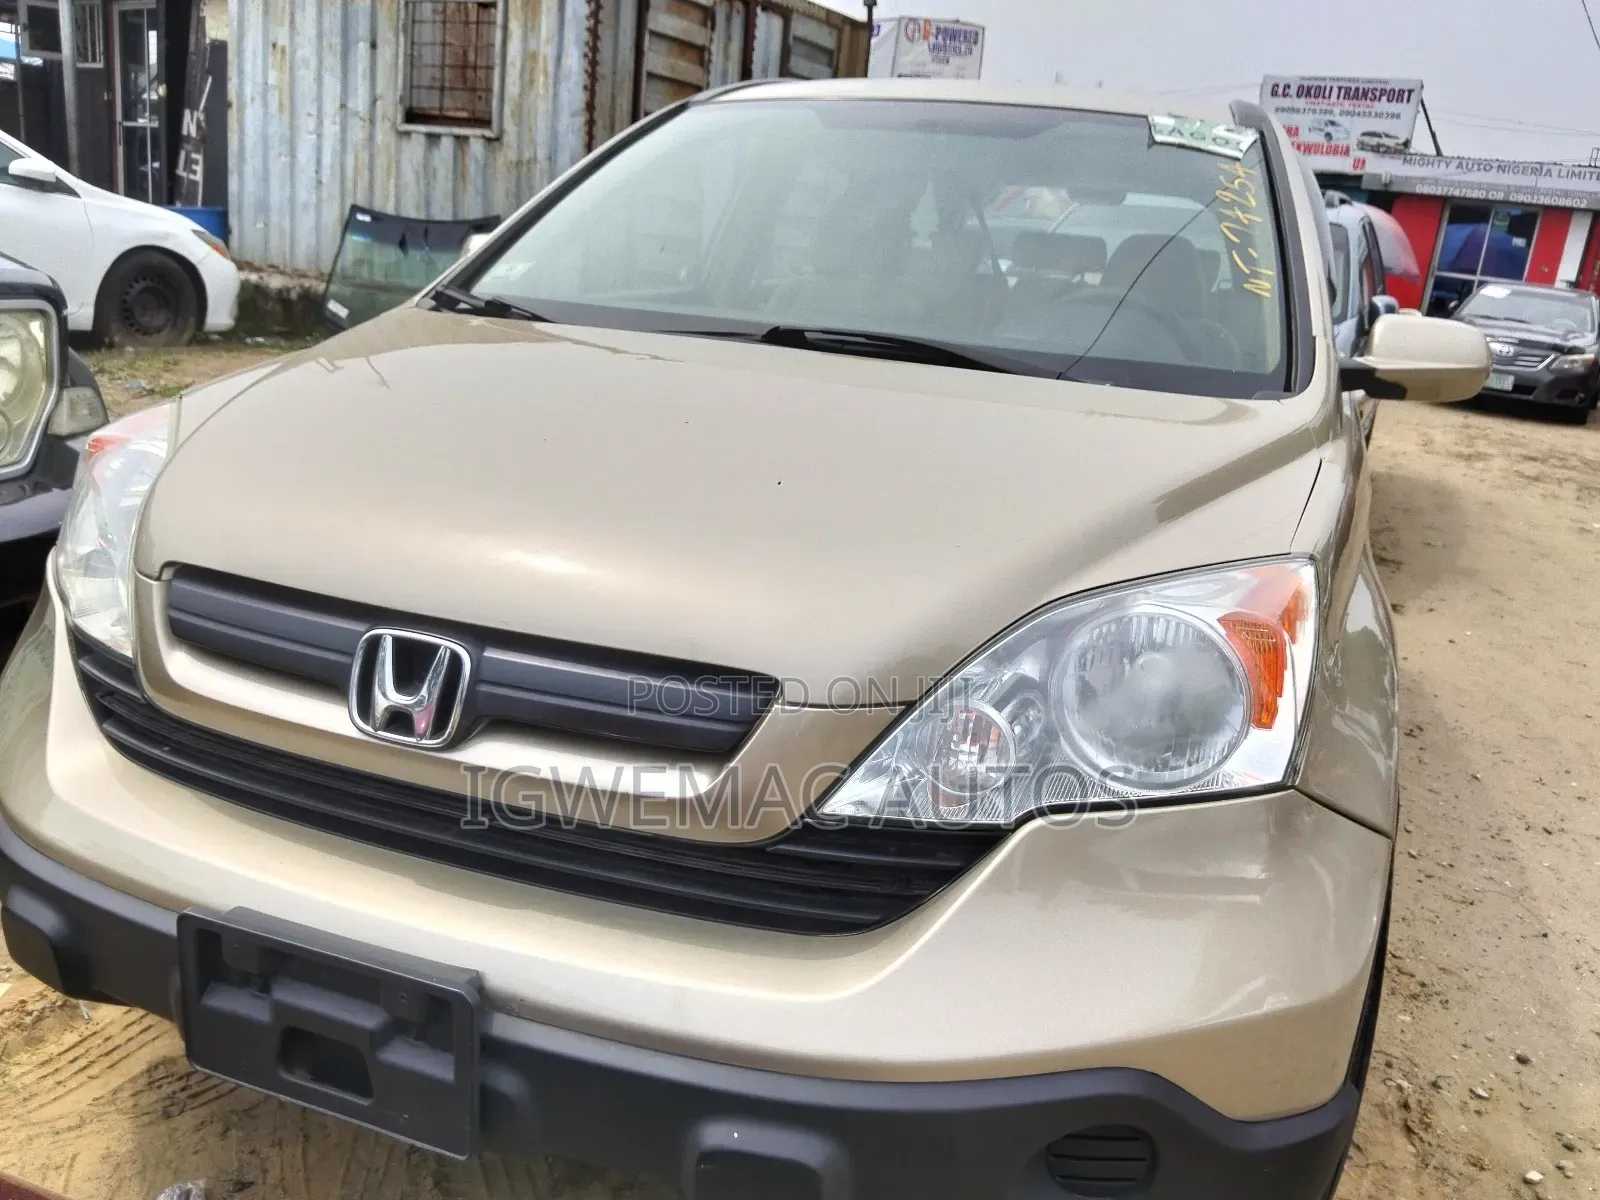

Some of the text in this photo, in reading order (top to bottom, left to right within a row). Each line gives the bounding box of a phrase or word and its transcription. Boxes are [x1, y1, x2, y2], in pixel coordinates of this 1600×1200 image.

[1295, 84, 1333, 100] OKOLI
[1336, 86, 1415, 104] TRANSPORT
[1402, 156, 1453, 170] MIGHTY
[1455, 160, 1493, 174] AUTO
[1496, 163, 1554, 179] NIGERIA
[1488, 189, 1504, 201] OR
